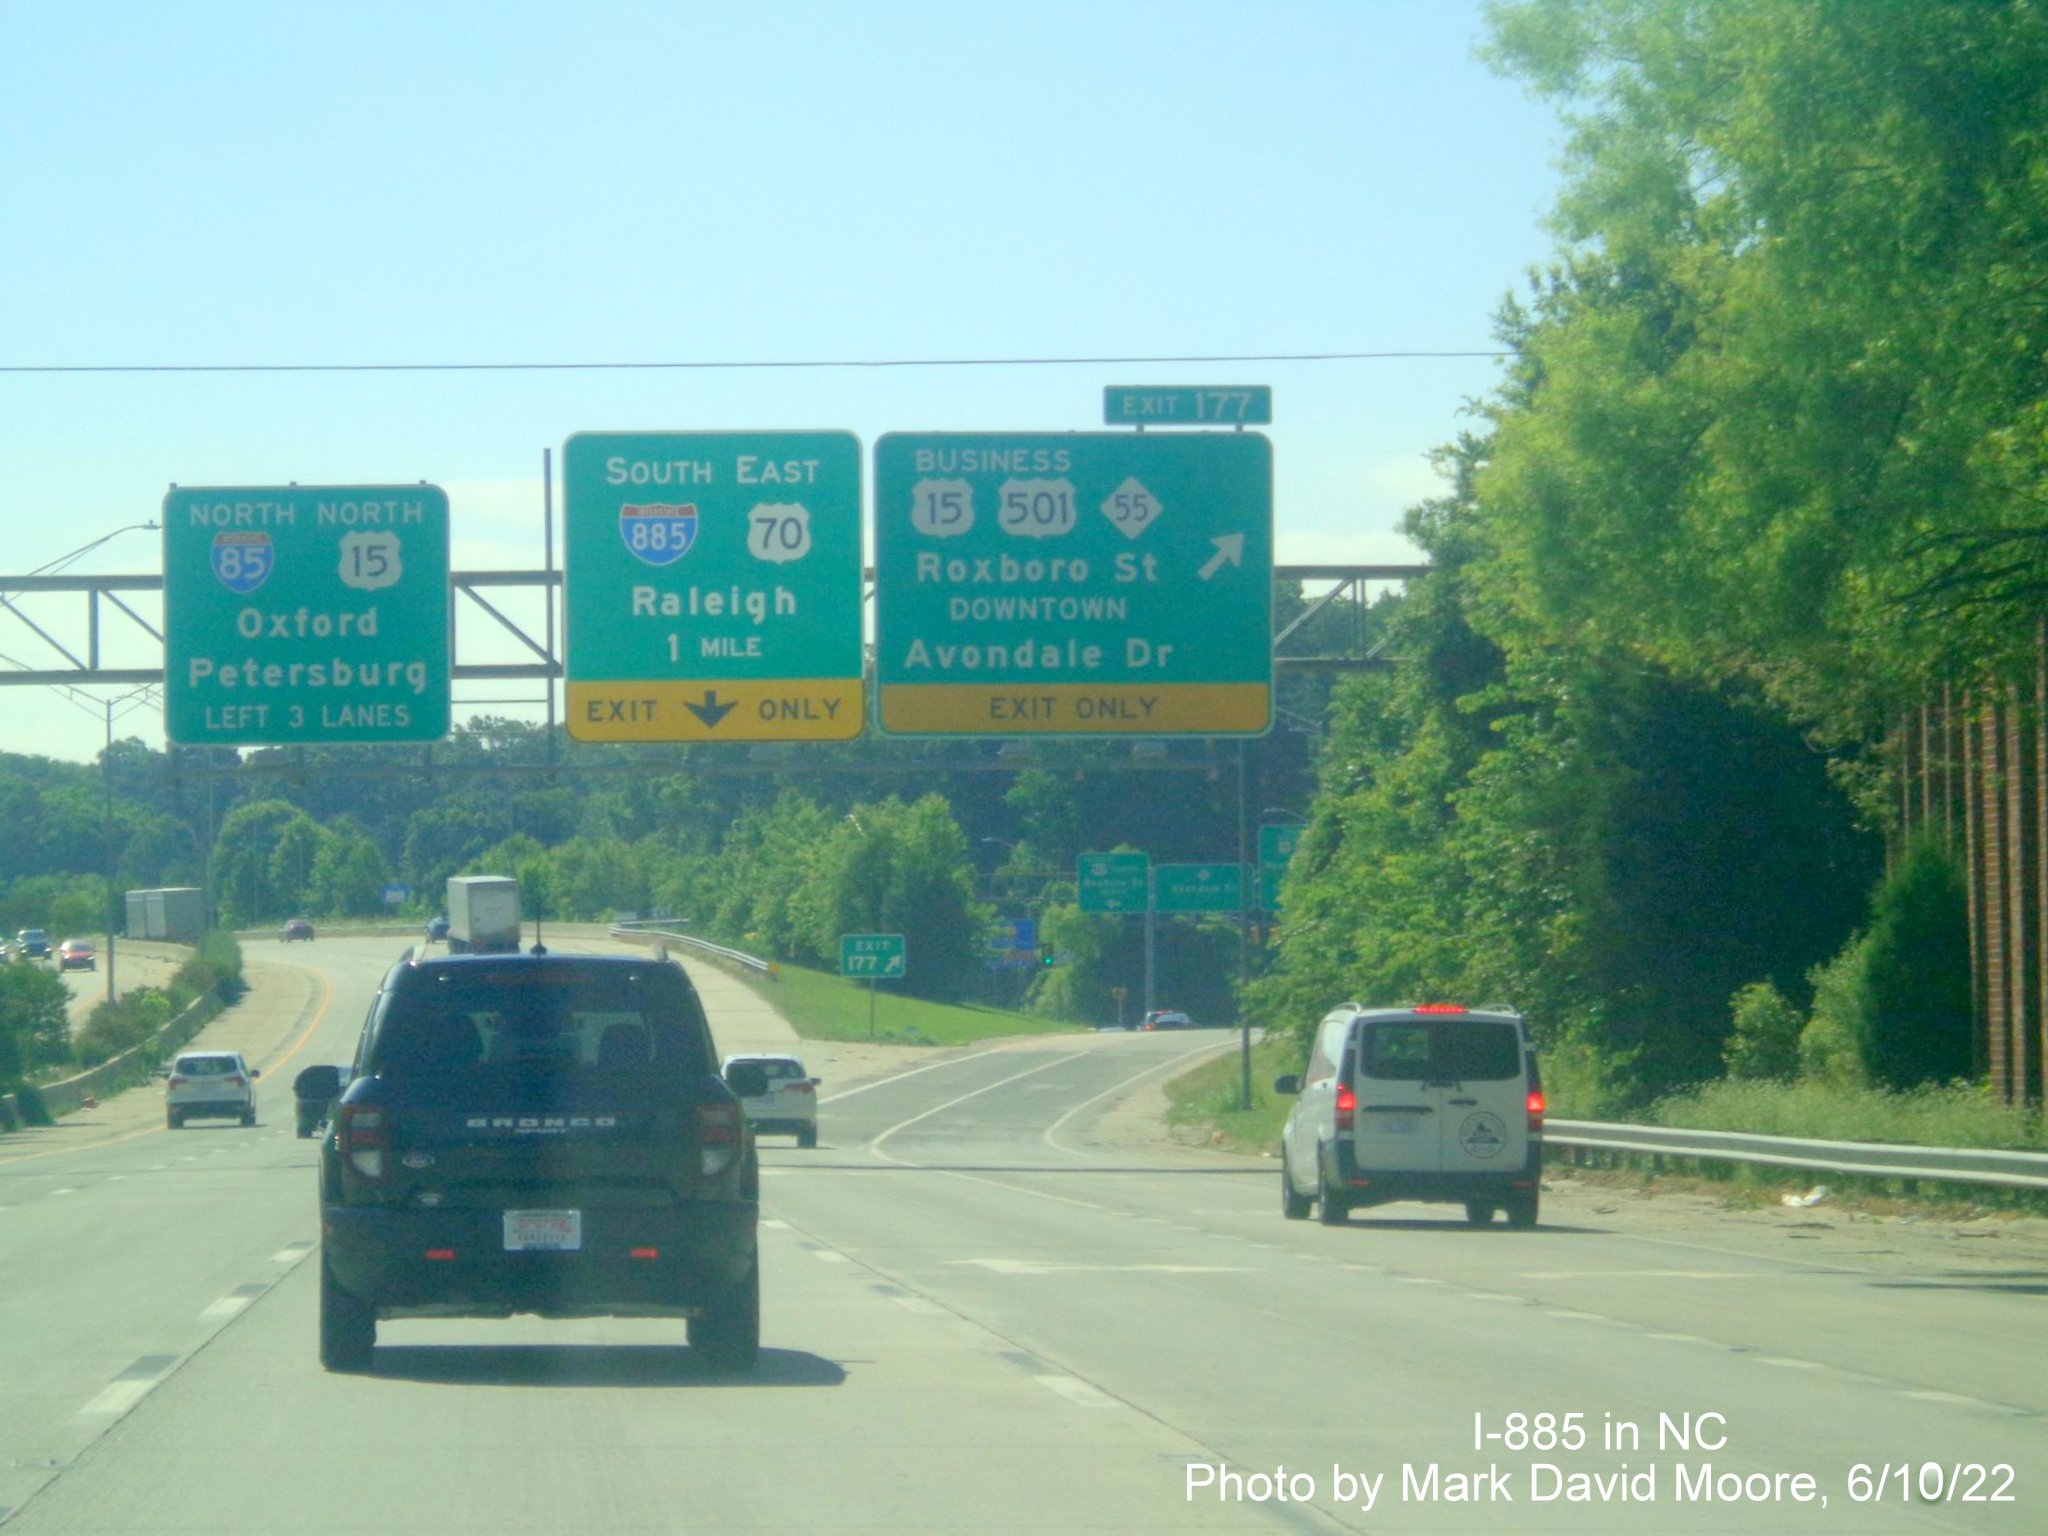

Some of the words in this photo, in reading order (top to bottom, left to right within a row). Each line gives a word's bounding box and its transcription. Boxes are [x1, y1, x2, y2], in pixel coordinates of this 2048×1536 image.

[1123, 395, 1178, 416] EXIT
[1197, 391, 1253, 418] 177
[606, 456, 713, 485] SOUTH
[736, 456, 819, 484] EAST
[916, 449, 1071, 472] BUSINESS
[190, 503, 295, 526] NORTH
[317, 501, 423, 525] NORTH
[927, 492, 963, 525] 15
[1007, 492, 1069, 524] 501
[1114, 494, 1148, 521] 55
[632, 523, 686, 550] 885
[755, 517, 804, 550] 70
[219, 547, 265, 579] 85
[352, 545, 389, 577] 15
[917, 552, 1089, 583] Roxboro
[1115, 552, 1158, 583] St
[632, 586, 796, 625] Raleigh
[950, 598, 1127, 621] DOWNTOWN
[237, 607, 378, 638] Oxford
[668, 634, 678, 662] 1
[701, 638, 761, 657] MILE
[904, 638, 1101, 669] Avondale
[1127, 638, 1173, 668] Dr
[189, 657, 427, 694] Petersburg
[205, 705, 269, 729] LEFT
[289, 705, 304, 728] 3
[322, 704, 411, 728] LANES
[587, 699, 658, 722] EXIT
[758, 698, 841, 721] ONLY
[990, 697, 1056, 719] EXIT
[1076, 696, 1158, 719] ONLY
[855, 941, 892, 950] EXIT
[848, 955, 877, 970] 177
[466, 1118, 616, 1127] BRONCO
